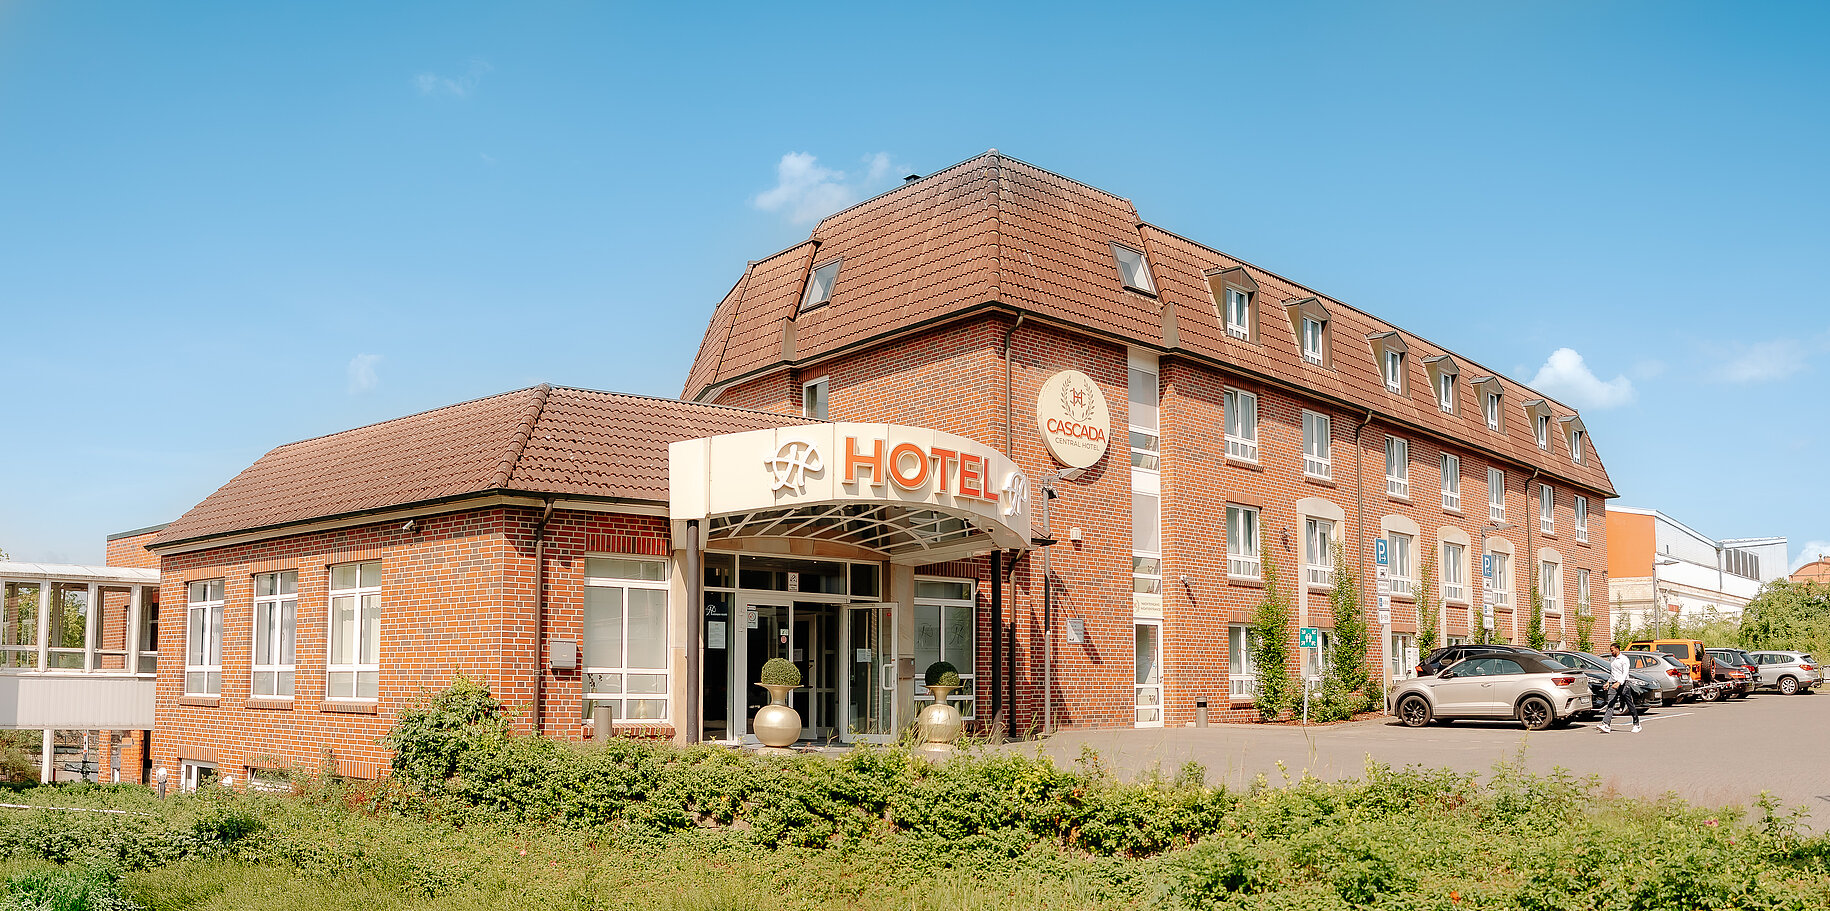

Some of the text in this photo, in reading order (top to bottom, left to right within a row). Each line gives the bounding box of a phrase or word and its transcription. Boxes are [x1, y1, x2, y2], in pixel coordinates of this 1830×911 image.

[1047, 418, 1106, 444] CASCADA
[1055, 437, 1100, 452] CENTRAL HOTEL
[843, 436, 1000, 502] HOTEL
[1378, 541, 1386, 561] P
[1484, 557, 1490, 574] P
